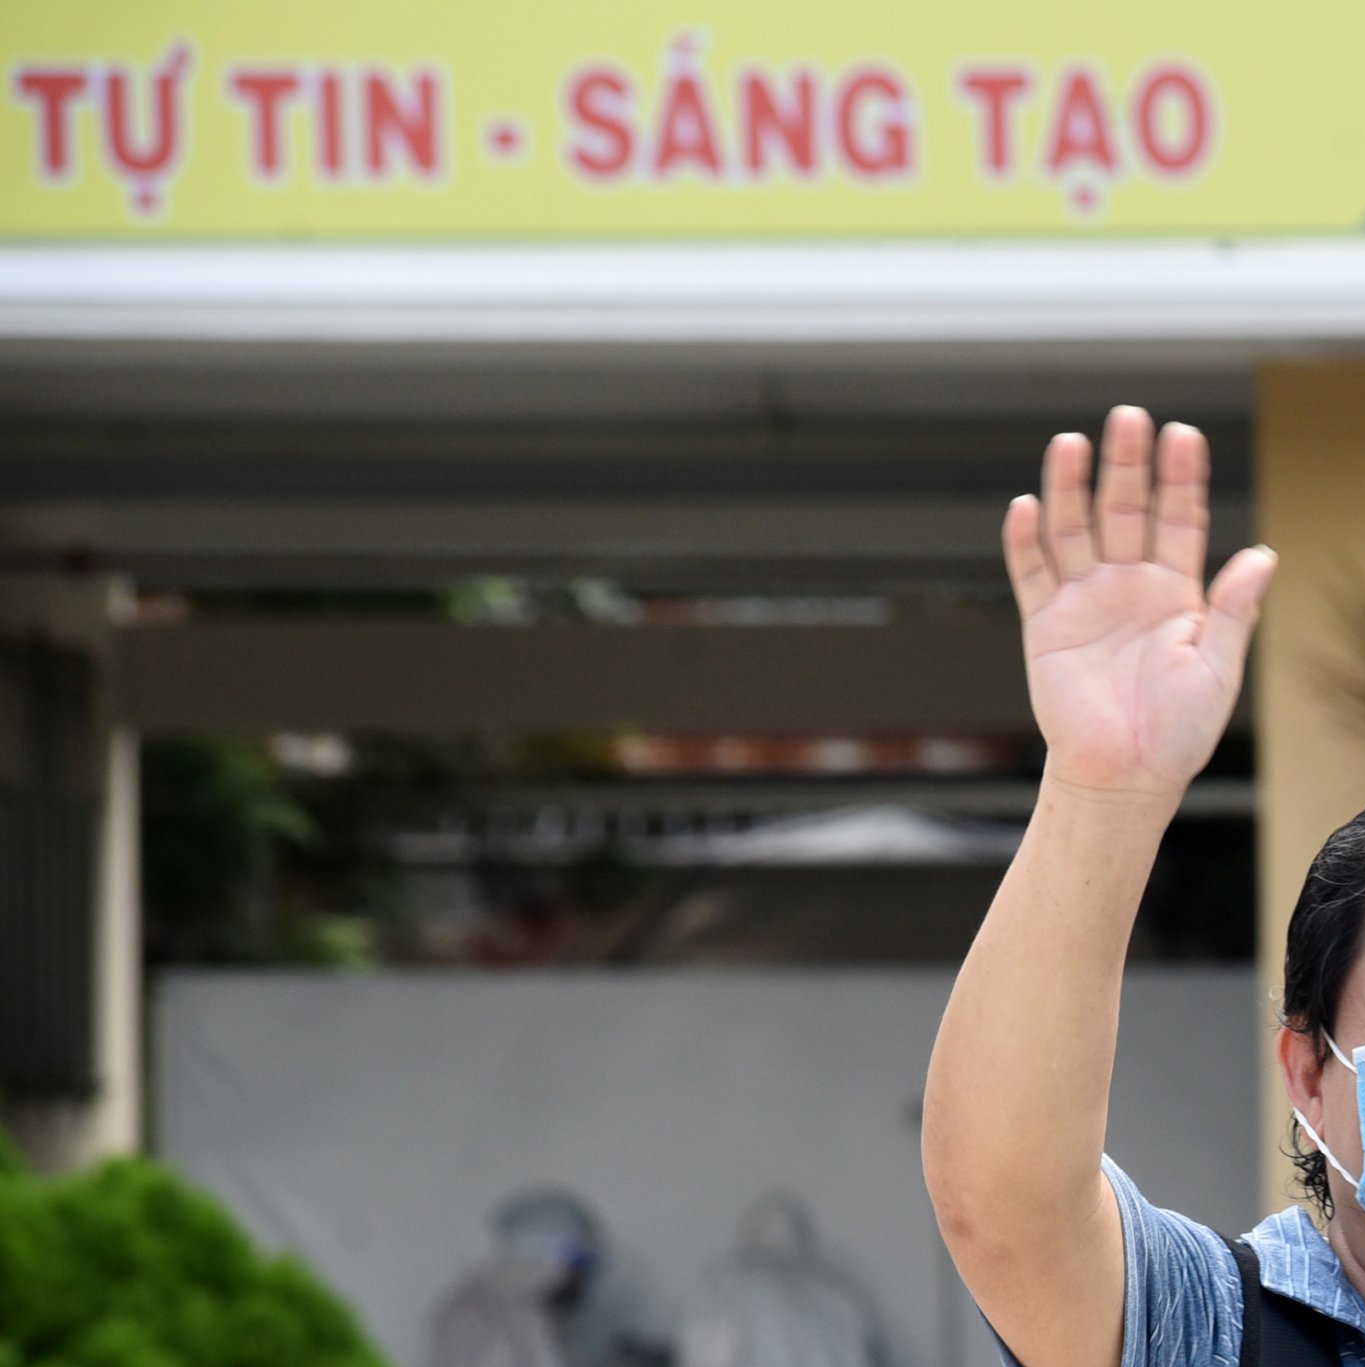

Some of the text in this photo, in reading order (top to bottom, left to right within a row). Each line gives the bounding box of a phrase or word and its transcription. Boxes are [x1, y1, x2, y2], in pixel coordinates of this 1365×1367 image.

[13, 44, 193, 214] TỰ
[226, 66, 446, 182] TIN
[563, 32, 918, 184] SÁNG
[954, 63, 1218, 213] TẠO
